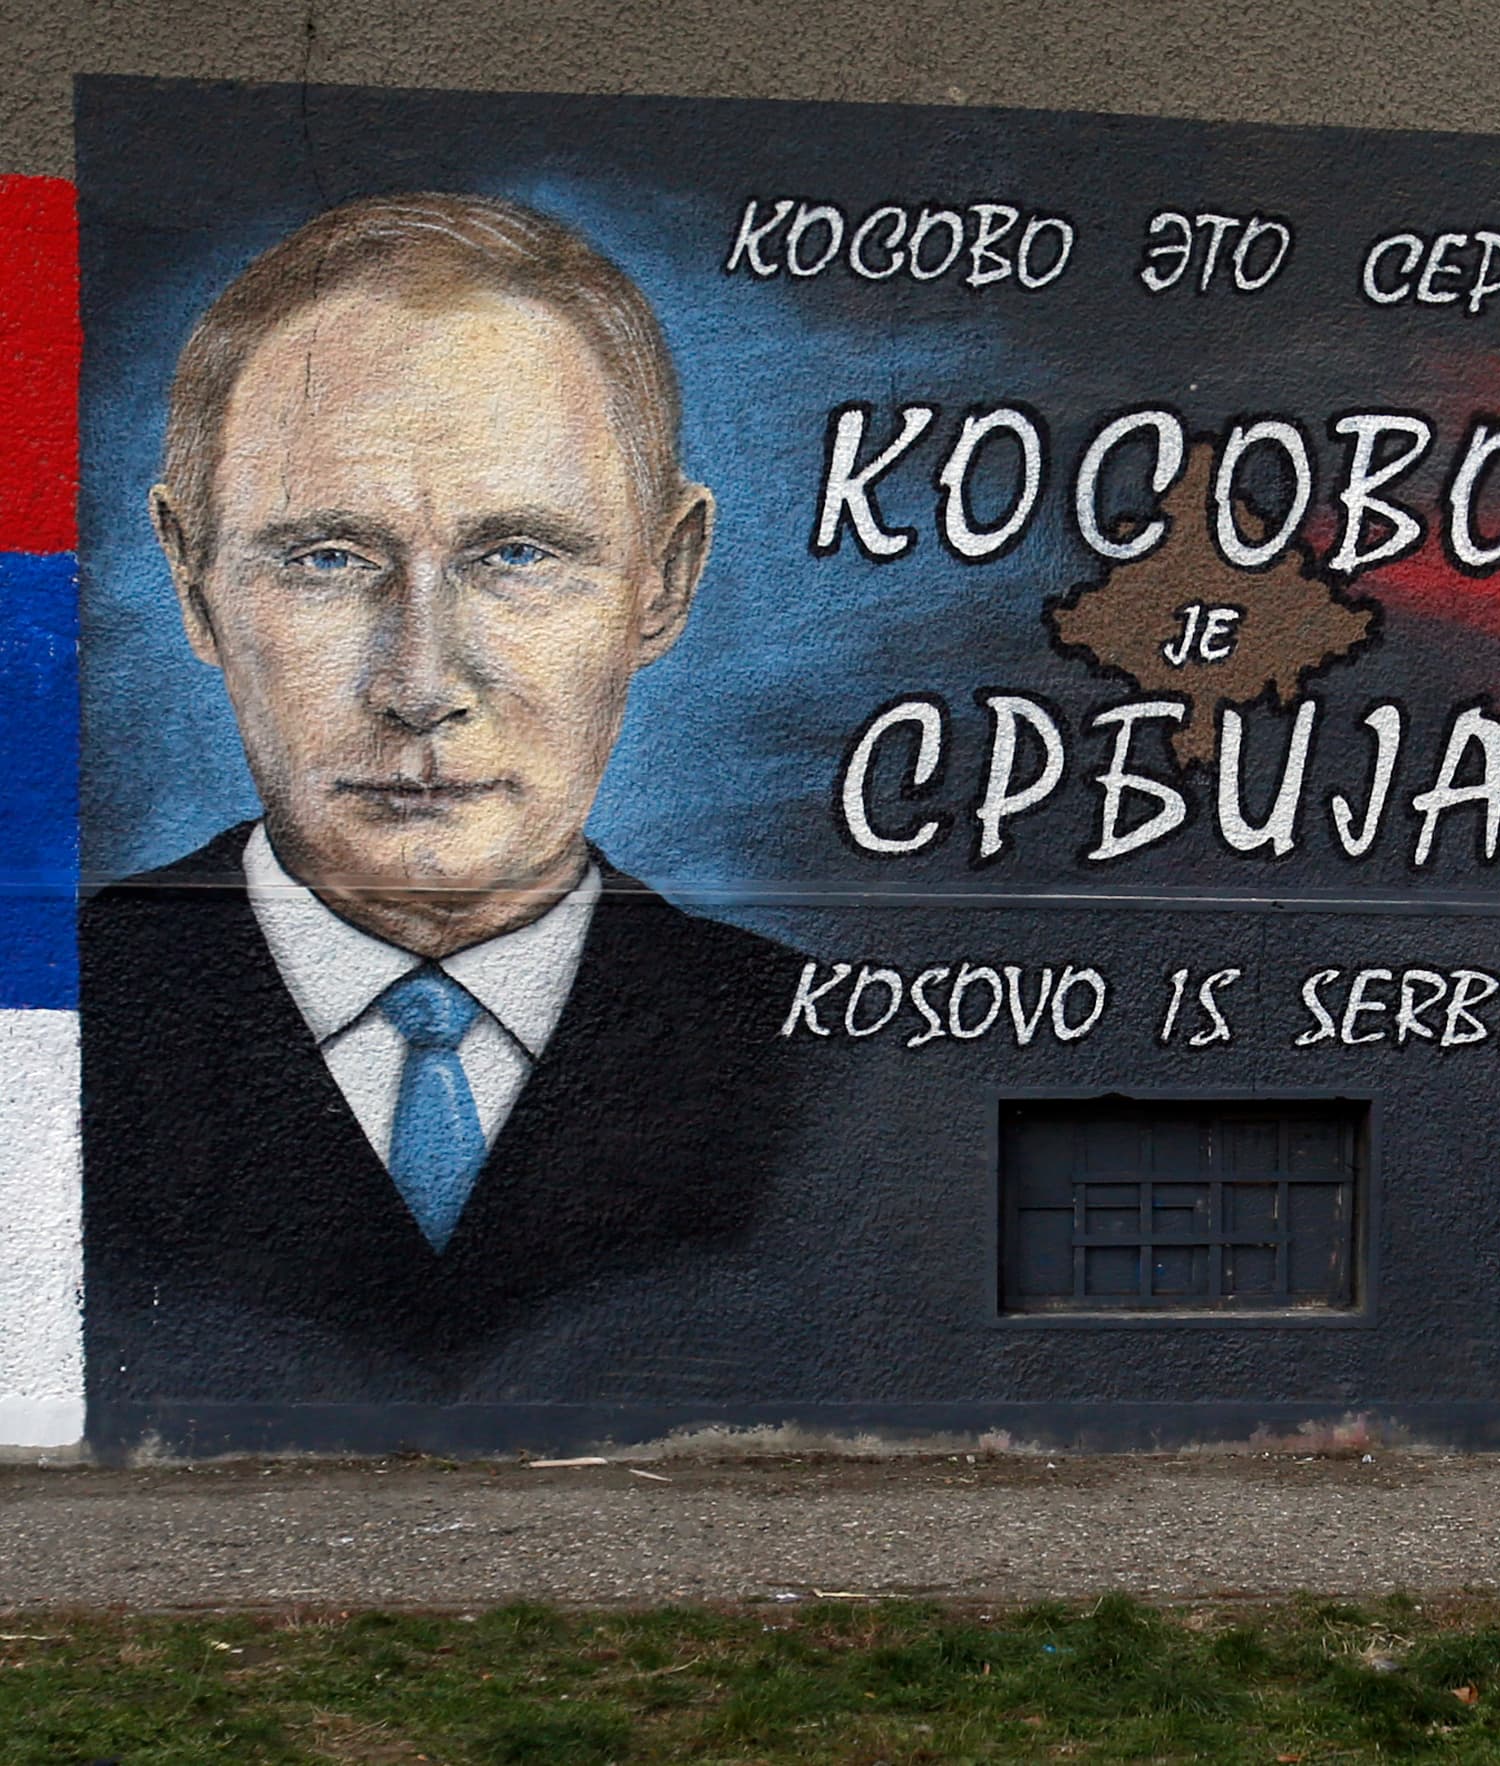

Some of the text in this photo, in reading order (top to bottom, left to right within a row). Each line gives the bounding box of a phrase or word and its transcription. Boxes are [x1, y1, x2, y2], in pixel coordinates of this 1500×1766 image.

[727, 200, 1074, 289] КОСОВО
[1141, 212, 1290, 292] ЭТО
[781, 961, 1107, 1048] KOSOVO
[1160, 968, 1242, 1047] IS
